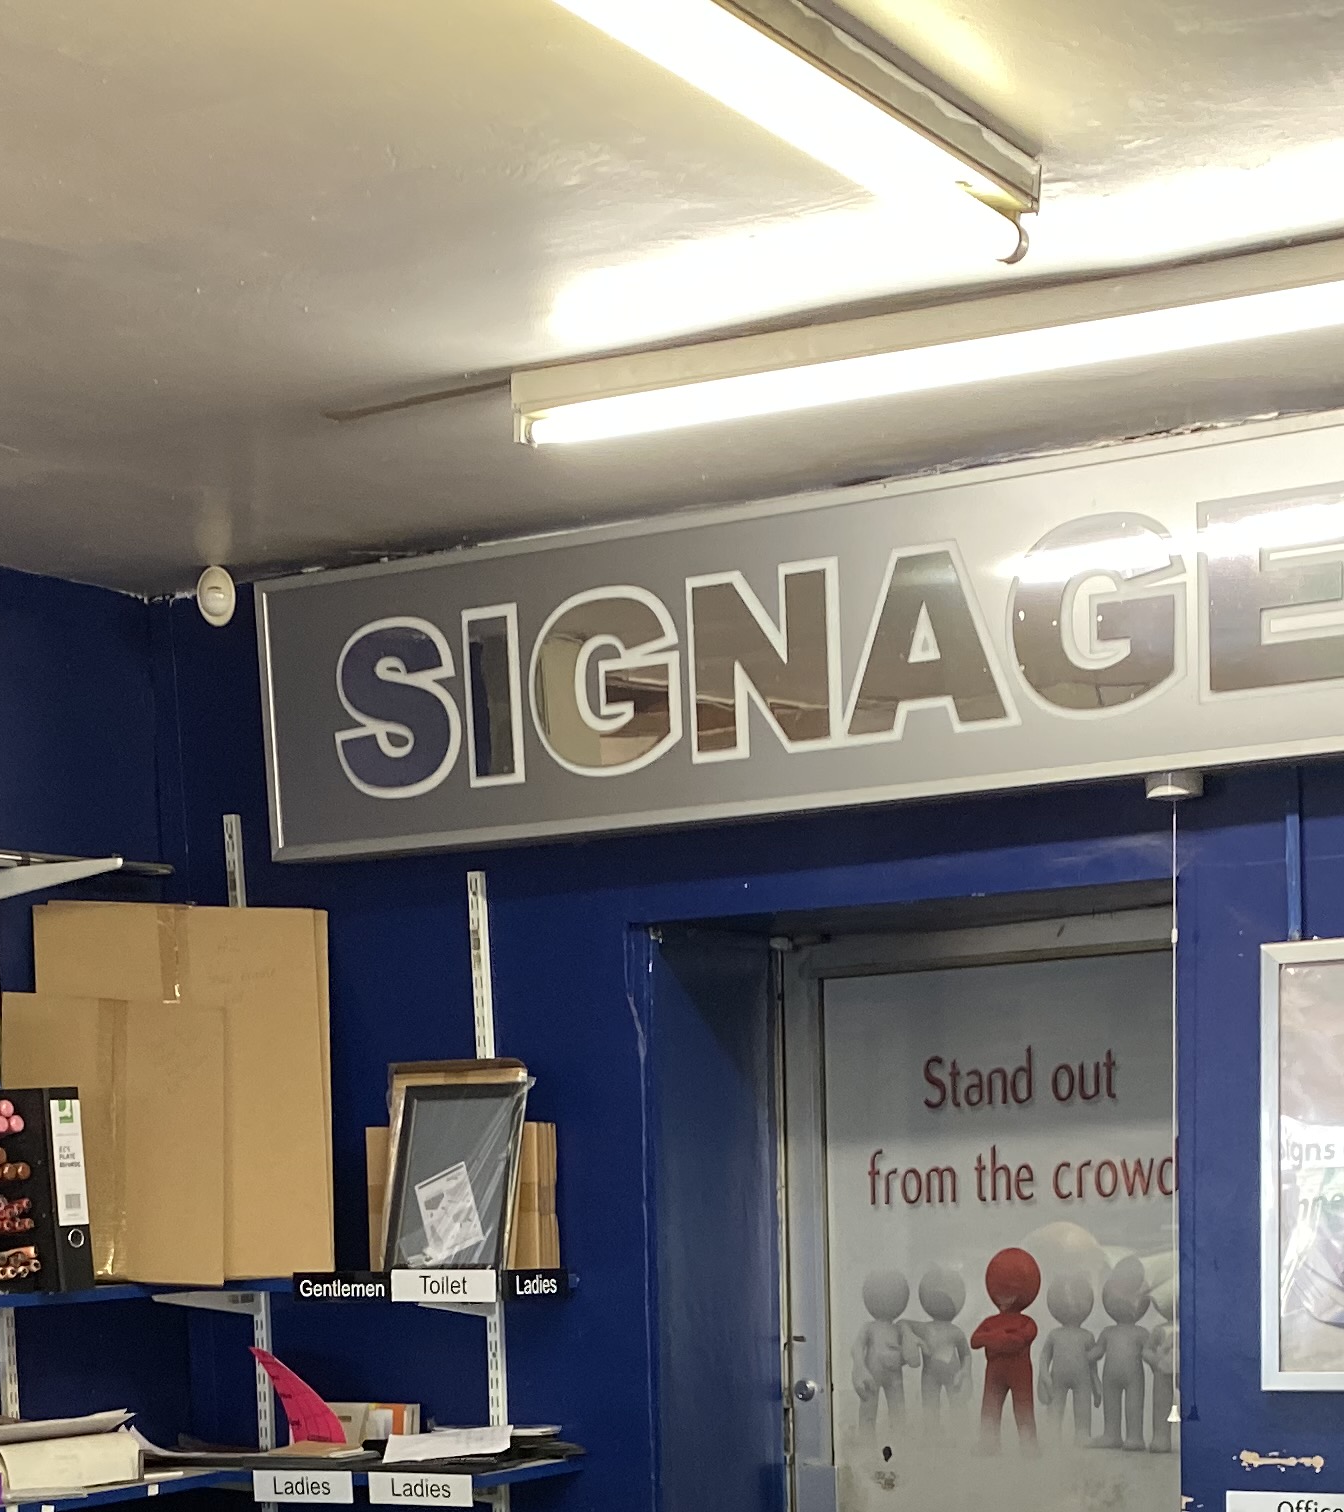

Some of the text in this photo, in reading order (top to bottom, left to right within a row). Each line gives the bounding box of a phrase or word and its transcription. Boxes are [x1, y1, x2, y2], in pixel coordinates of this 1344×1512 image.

[923, 1045, 1117, 1109] Stand out
[868, 1148, 957, 1206] from
[975, 1144, 1035, 1202] the
[299, 1279, 386, 1300] Gentlemen
[418, 1273, 468, 1296] Toilet
[515, 1273, 558, 1295] Ladies
[273, 1475, 331, 1497] Ladies
[390, 1478, 452, 1500] Ladies
